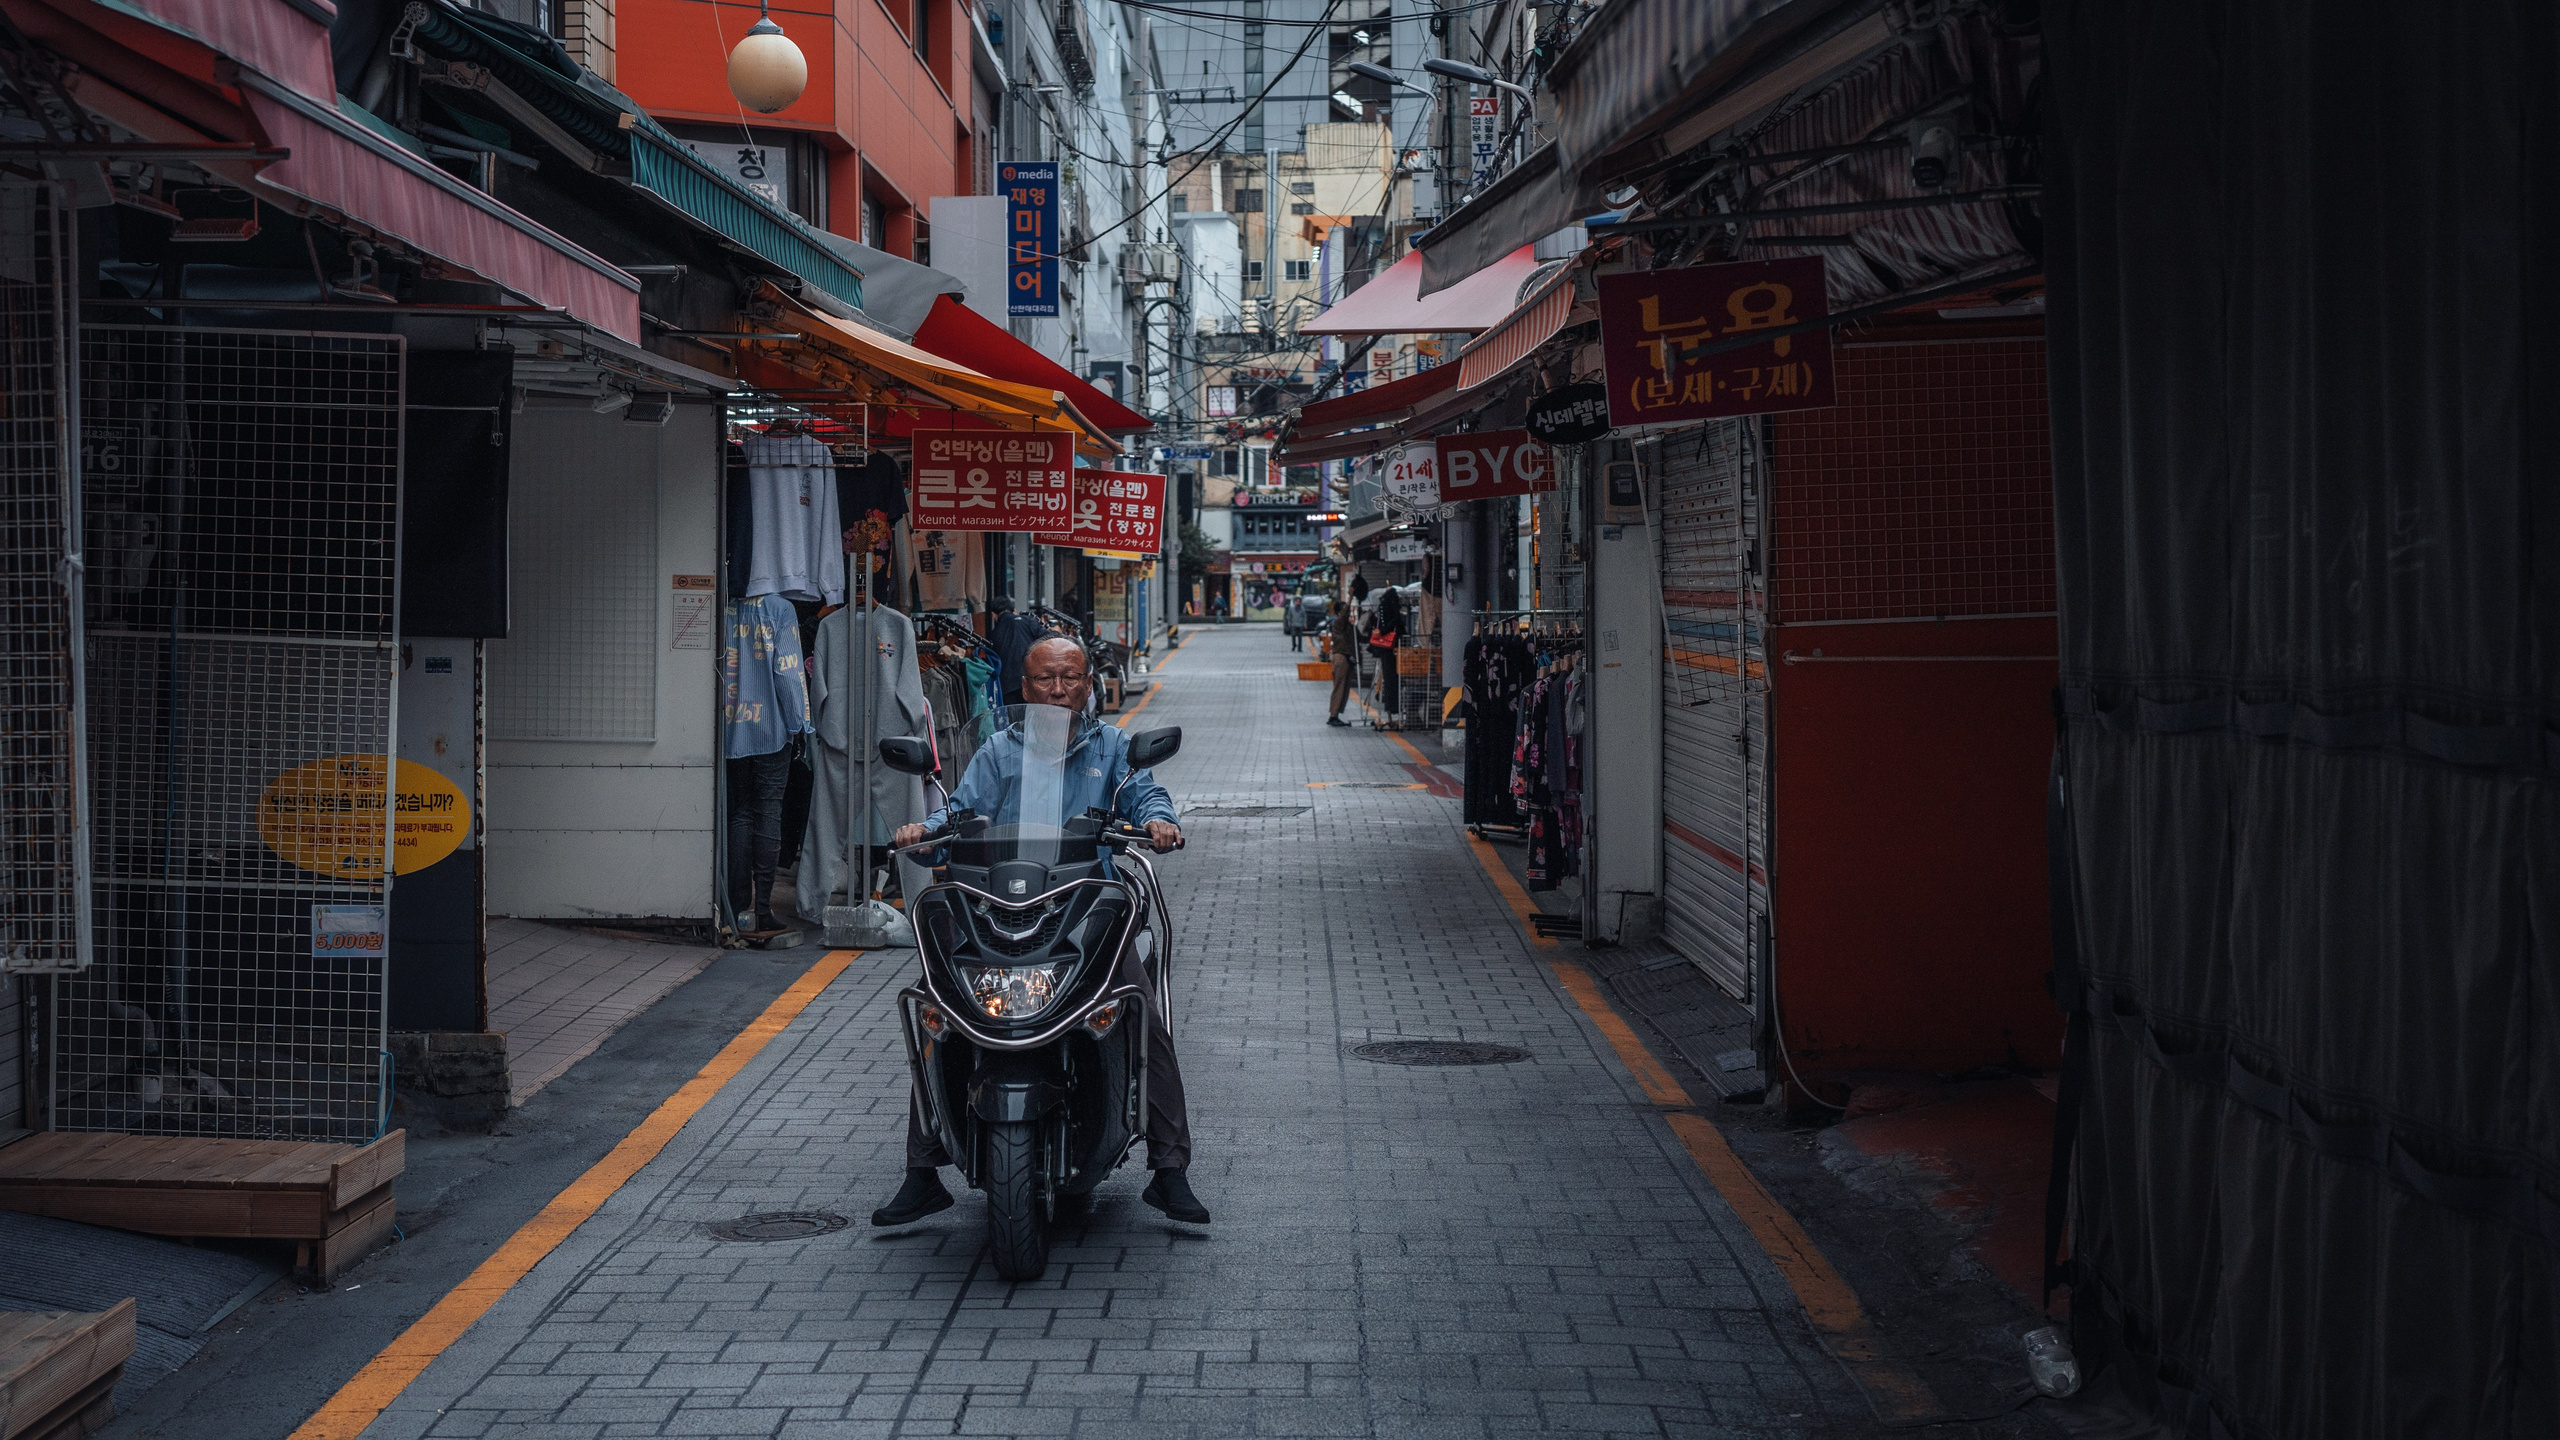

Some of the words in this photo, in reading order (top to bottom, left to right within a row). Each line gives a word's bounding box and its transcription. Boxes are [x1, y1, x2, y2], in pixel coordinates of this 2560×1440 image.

[1017, 168, 1054, 180] media
[1010, 187, 1046, 206] 재영
[1015, 209, 1042, 298] 미디어
[1008, 304, 1055, 313] 산판매대리점
[81, 444, 120, 471] 16
[930, 439, 1053, 464] 언박싱(올맨)
[1393, 457, 1439, 481] 21세
[1447, 442, 1545, 488] BYC
[918, 467, 997, 509] 큰옷
[1004, 492, 1067, 511] (추리닝)
[918, 514, 957, 526] Keunot
[962, 516, 1004, 526] магазин
[1009, 515, 1066, 527] ビックサイズ
[1074, 498, 1102, 531] 옷
[1040, 532, 1070, 542] Keunot
[1073, 535, 1107, 545] магазин
[1109, 536, 1154, 549] ビックサイズ
[394, 823, 420, 833] 과태료가
[420, 823, 454, 833] 부과됩니다.
[315, 933, 384, 950] 5,000원
